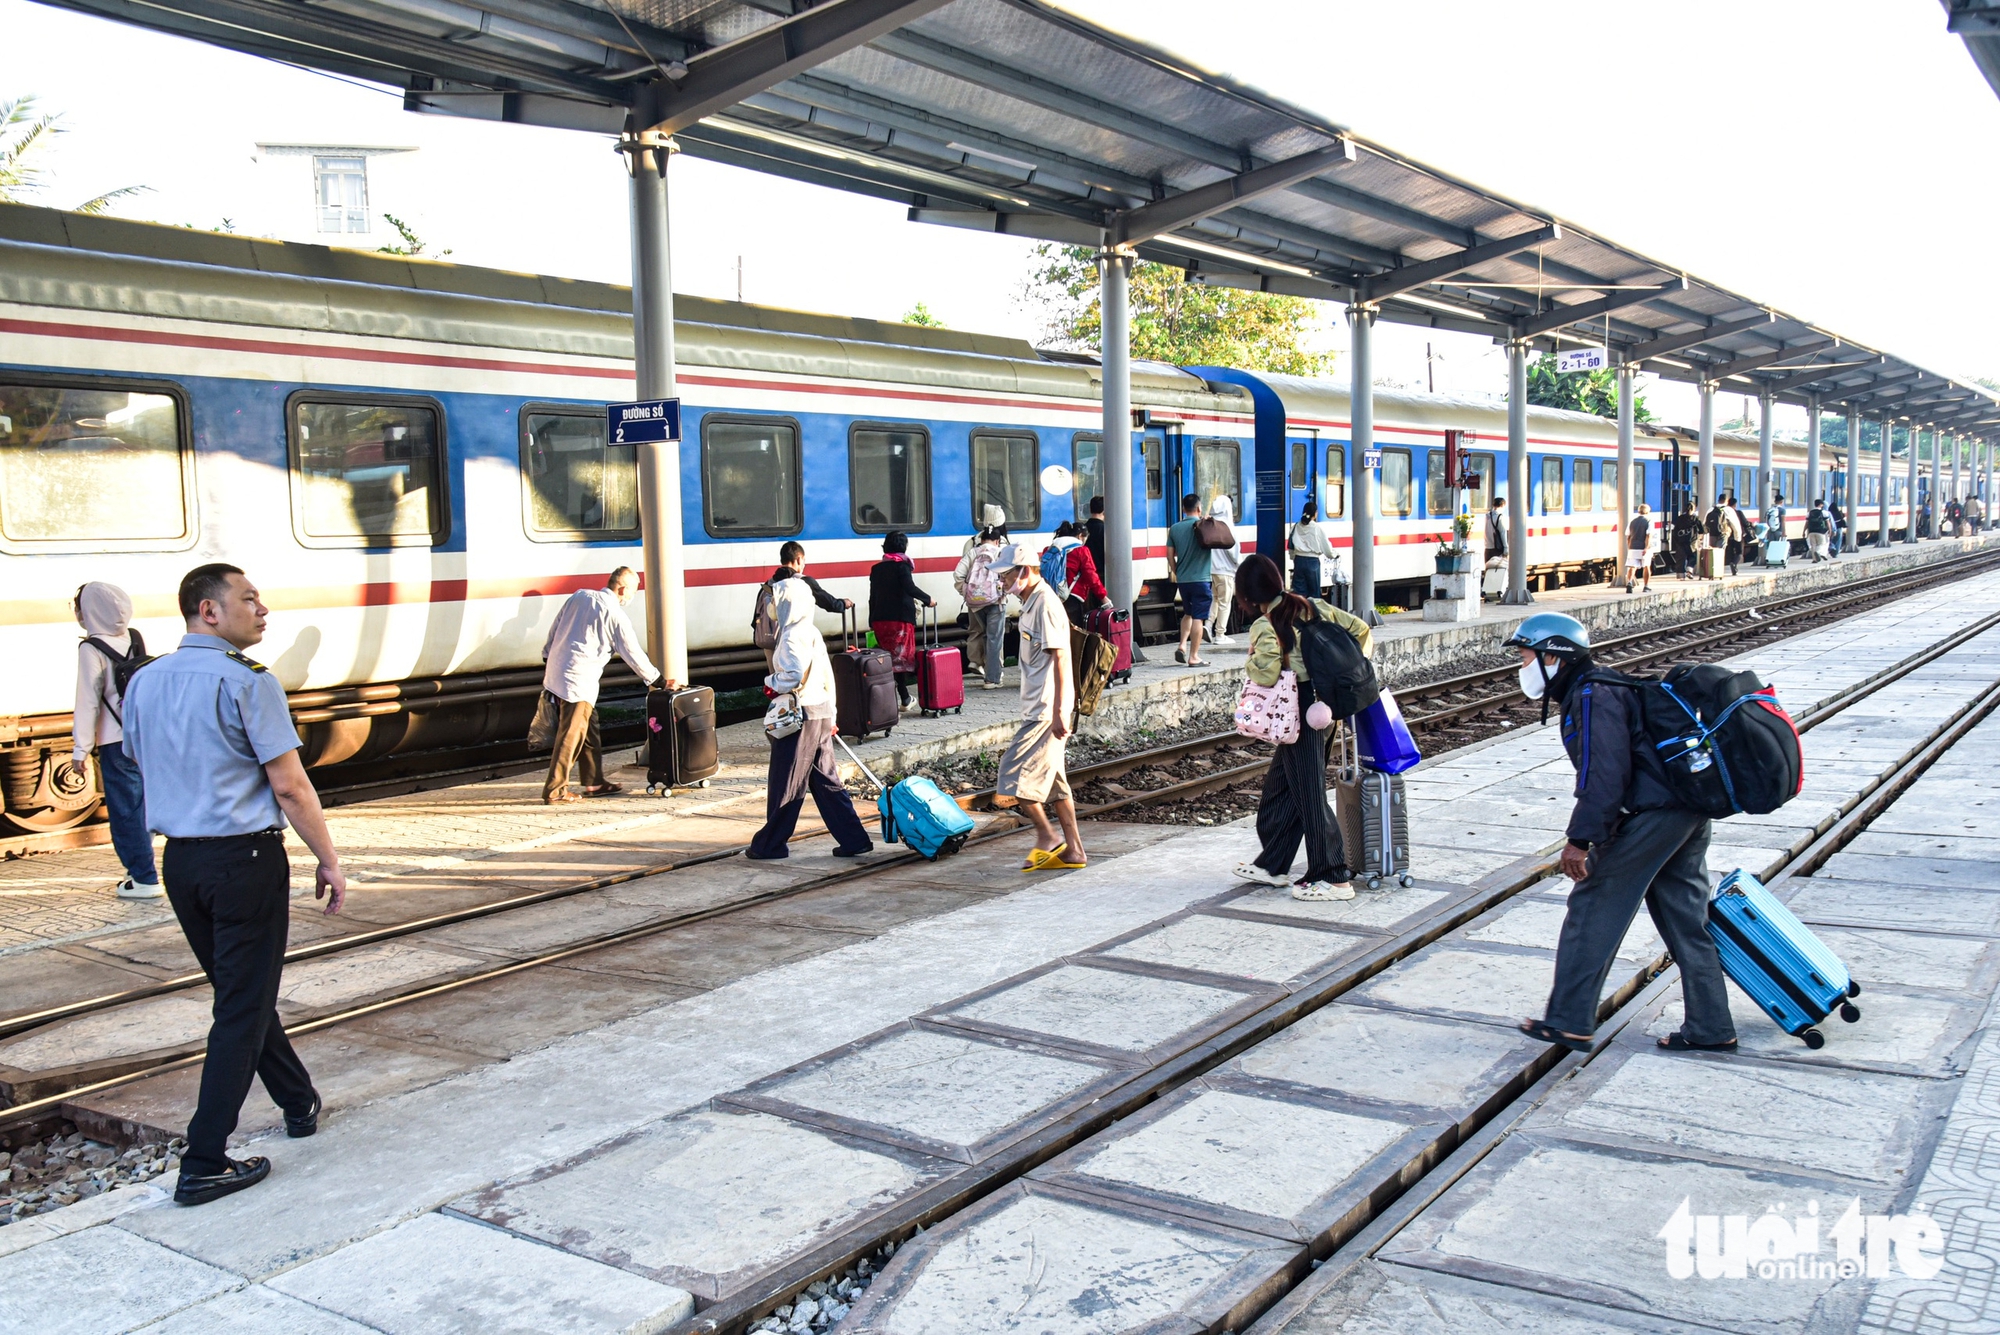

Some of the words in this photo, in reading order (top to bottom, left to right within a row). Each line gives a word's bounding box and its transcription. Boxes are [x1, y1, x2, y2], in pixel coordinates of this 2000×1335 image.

[622, 406, 651, 420] ĐƯỜNG
[652, 402, 664, 417] SỐ
[616, 428, 625, 442] 2
[663, 425, 670, 439] 1
[1546, 640, 1575, 652] Vespa
